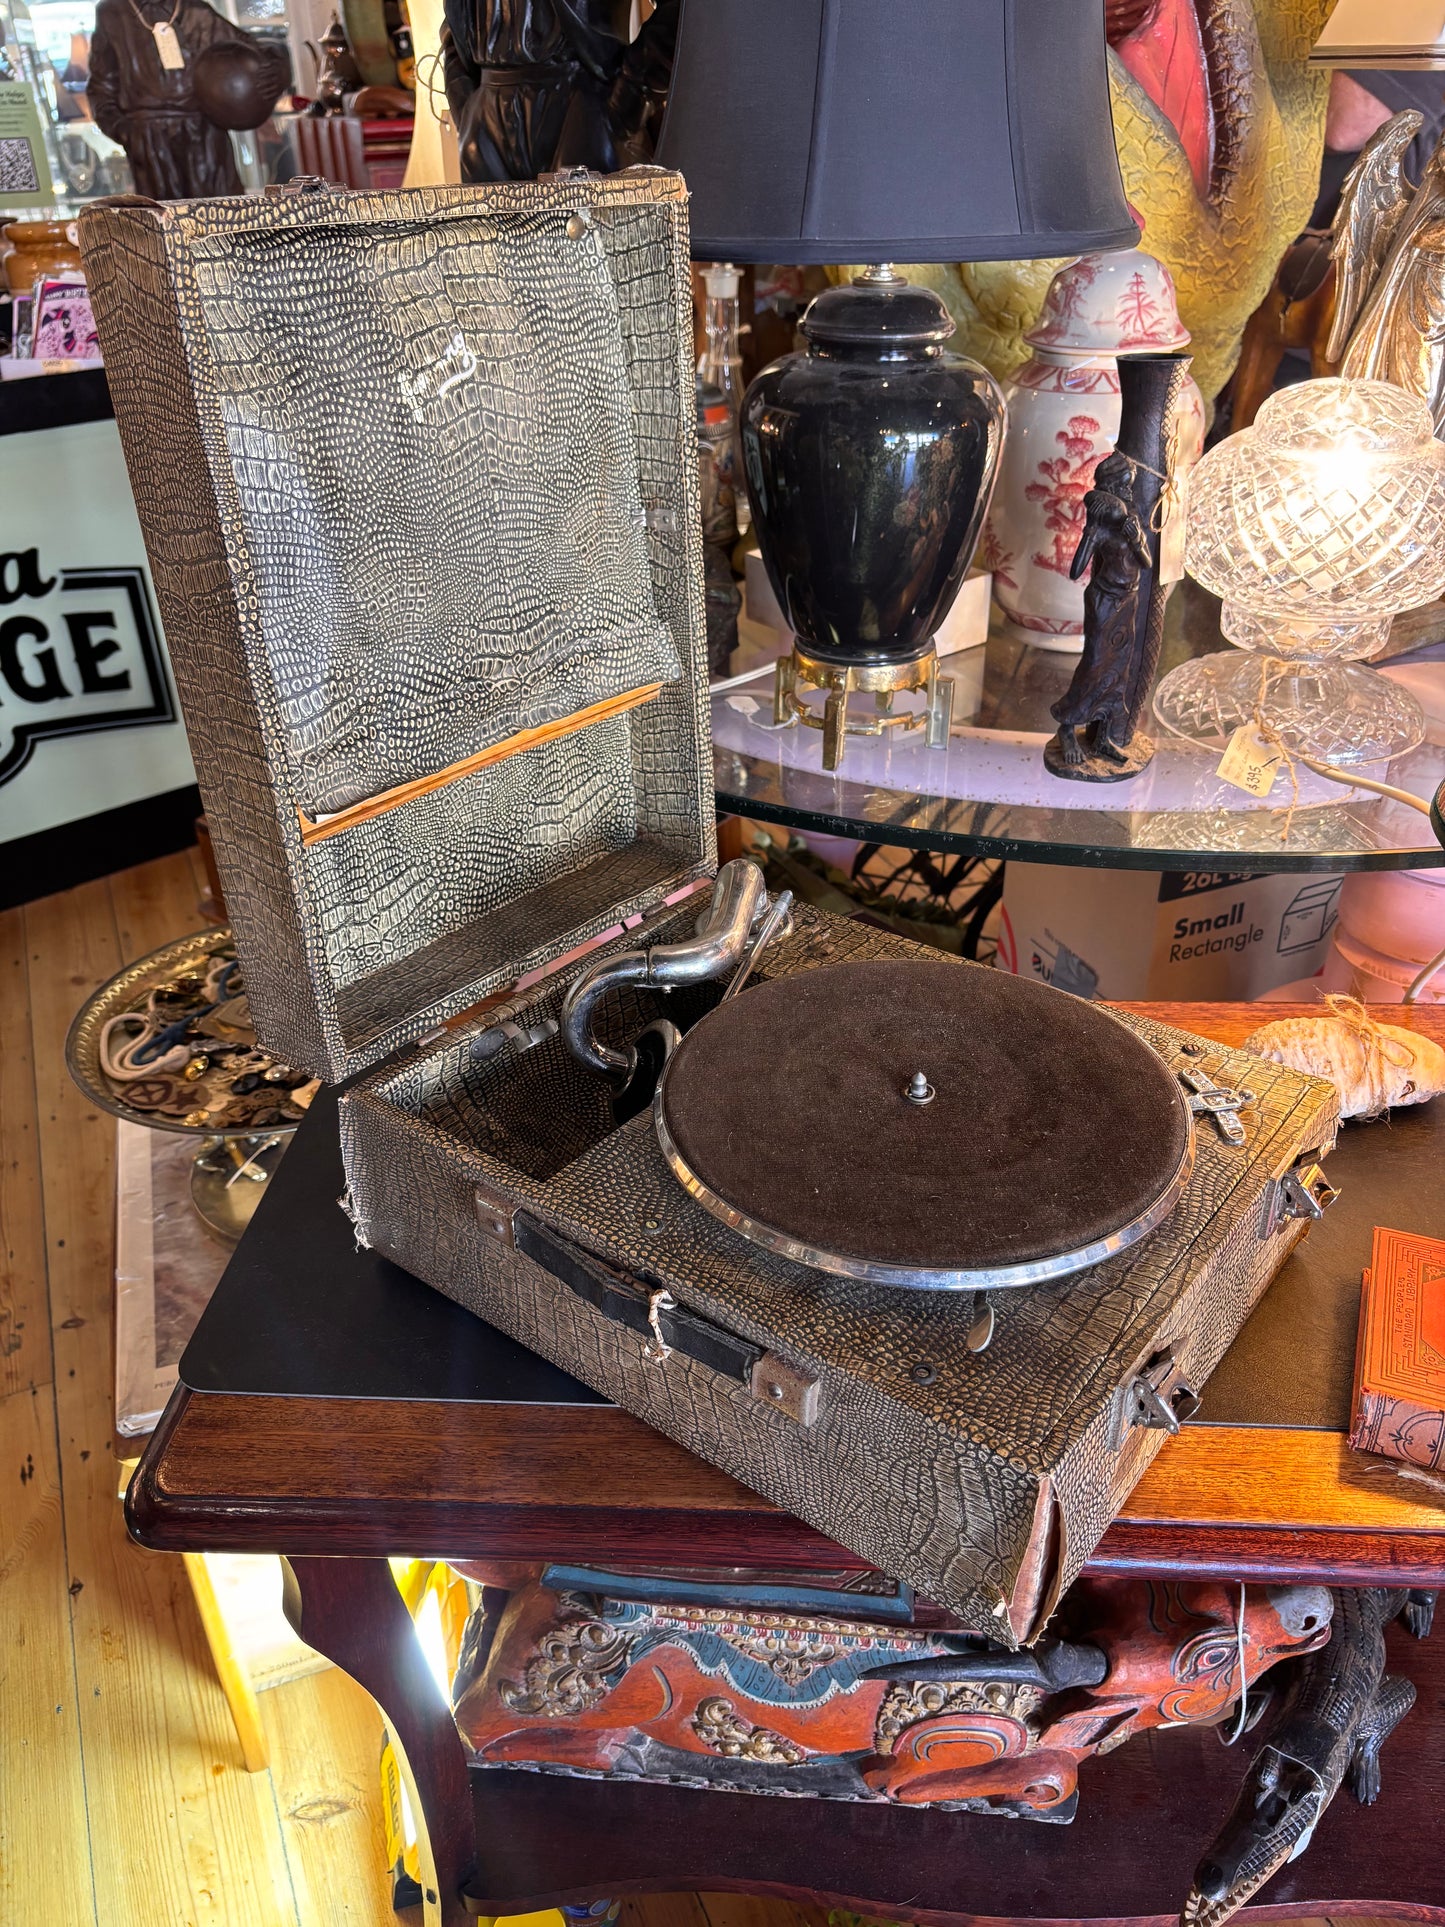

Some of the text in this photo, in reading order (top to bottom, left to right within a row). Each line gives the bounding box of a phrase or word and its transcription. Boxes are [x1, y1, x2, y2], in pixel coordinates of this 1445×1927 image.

[0, 611, 132, 705] GE
[1169, 923, 1264, 963] Rectangle
[1173, 902, 1246, 940] Small
[1394, 1277, 1406, 1334] THE PEOPLE'S
[1403, 1268, 1417, 1350] STANDARD LIBRARY
